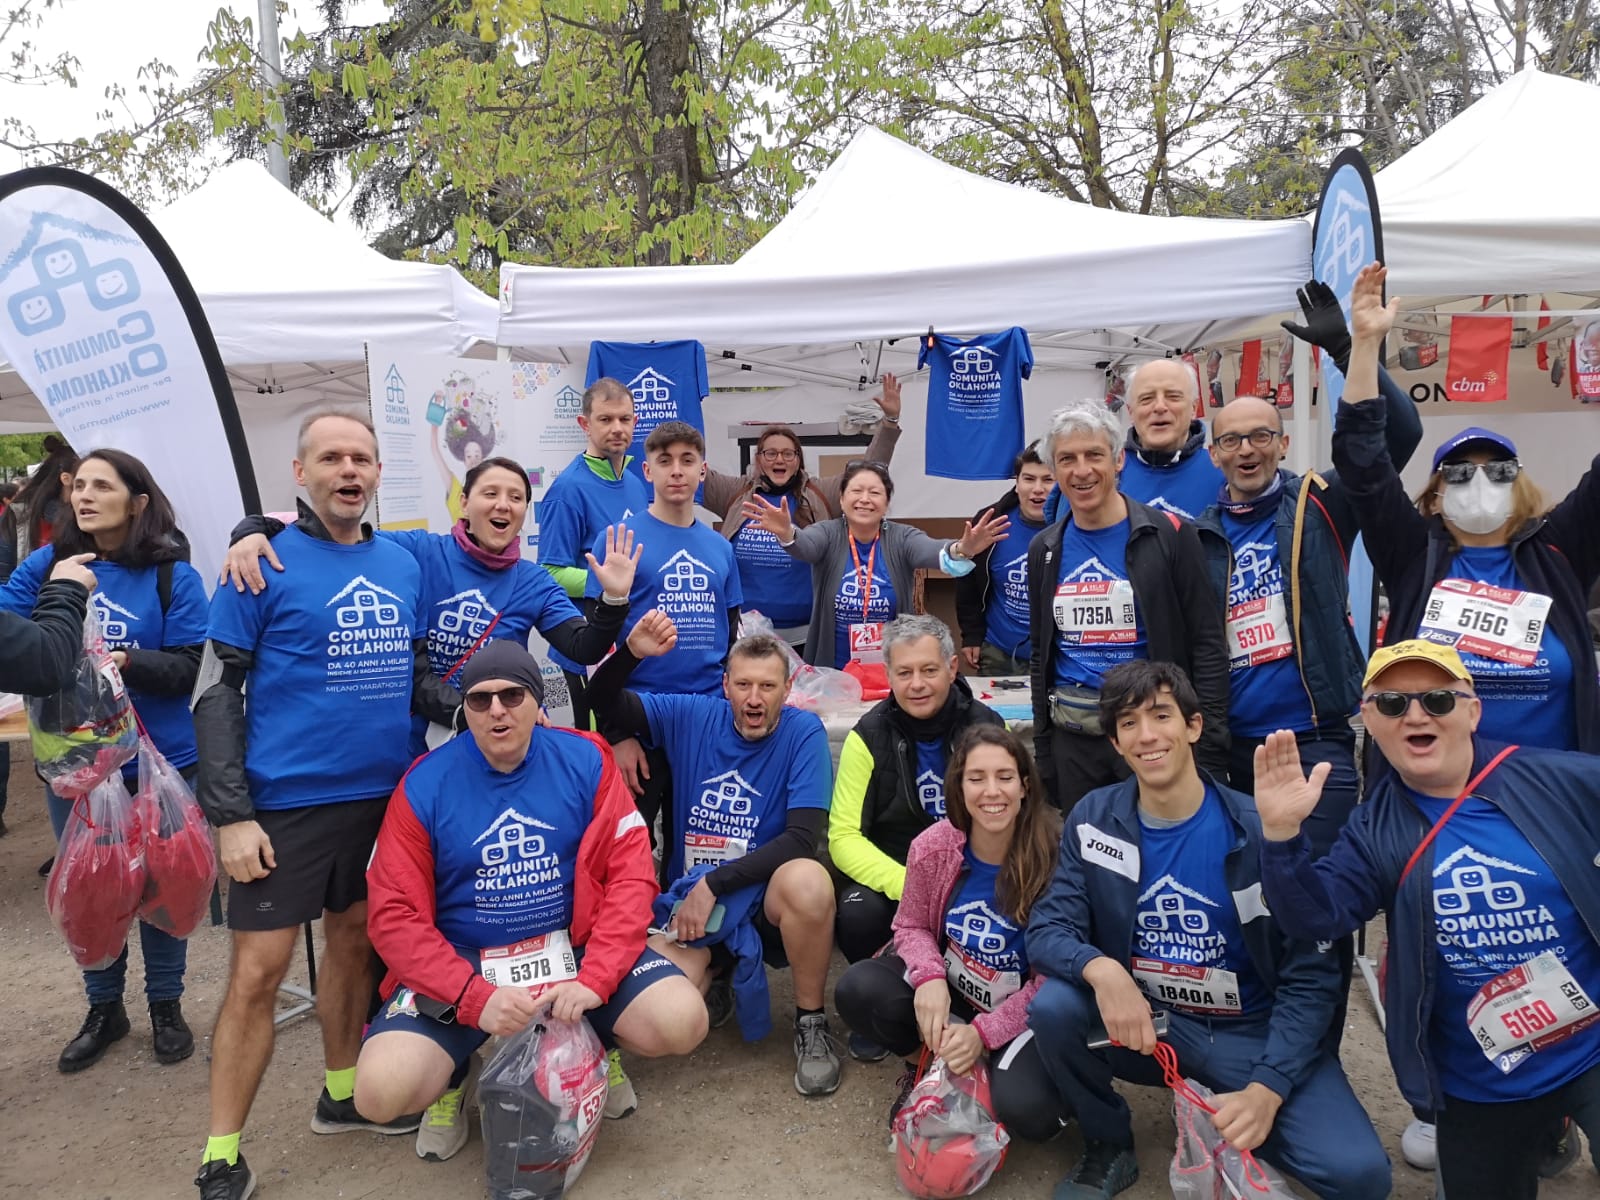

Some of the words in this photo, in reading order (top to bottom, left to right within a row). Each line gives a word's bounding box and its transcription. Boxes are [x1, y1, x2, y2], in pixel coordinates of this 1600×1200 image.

[950, 371, 1001, 382] COMUNITÀ
[949, 381, 1001, 391] OKLAHOMA
[1452, 376, 1486, 392] cbm
[634, 400, 677, 411] OMUNITÀ
[634, 411, 677, 420] LAHOMA
[739, 534, 777, 542] OKLAHO
[741, 528, 776, 536] COMU
[657, 591, 716, 603] COMUNITÀ
[1005, 588, 1029, 600] OKLA
[657, 603, 715, 614] OKLAHOMA
[1072, 606, 1114, 625] 1735A
[1457, 608, 1508, 637] 515C
[328, 624, 410, 643] COMUNITÀ
[327, 640, 410, 657] OKLAHOMA
[1083, 651, 1117, 659] MARATON
[328, 662, 341, 670] DA
[344, 661, 356, 669] 40
[357, 659, 378, 668] ANNI
[1463, 659, 1491, 669] ANNI
[325, 684, 359, 693] MILANO
[691, 805, 760, 828] COMUNITÀ
[475, 852, 559, 878] COMUNITÀ
[474, 868, 561, 891] OKLAHOMA
[502, 893, 523, 901] ANNI
[532, 884, 563, 897] MILANO
[475, 916, 504, 925] MILANO
[505, 911, 548, 924] MARATHON
[1436, 925, 1560, 948] OKLAHOMA
[1139, 938, 1225, 963] OKLAHOMA
[1444, 953, 1462, 962] DA
[1478, 953, 1504, 963] ANNI
[1507, 953, 1516, 961] A
[510, 958, 552, 983] 537B
[957, 973, 992, 1008] 535A
[1158, 984, 1215, 1005] 1840A
